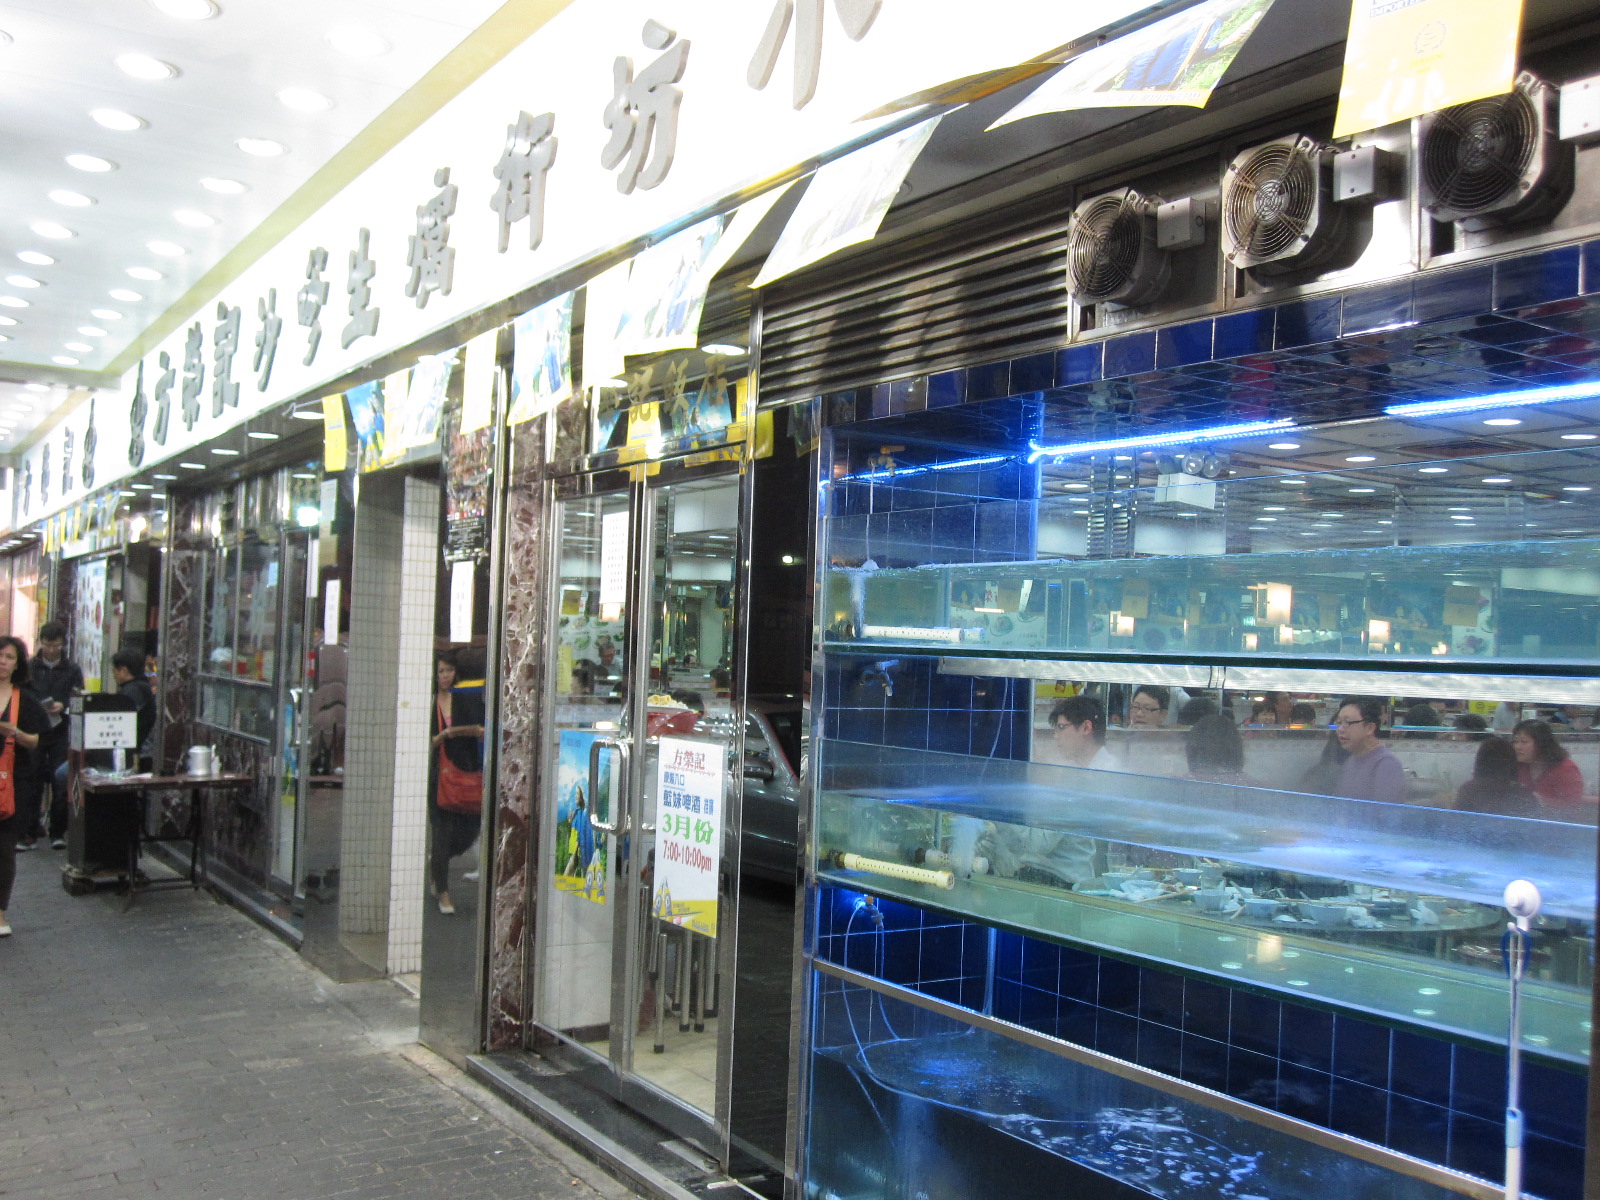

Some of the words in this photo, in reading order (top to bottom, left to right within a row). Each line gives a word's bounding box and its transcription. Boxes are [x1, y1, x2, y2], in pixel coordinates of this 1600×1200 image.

[672, 748, 706, 771] 方榮記
[662, 813, 715, 845] 3月份
[663, 840, 713, 874] 7:00-10:00pm
